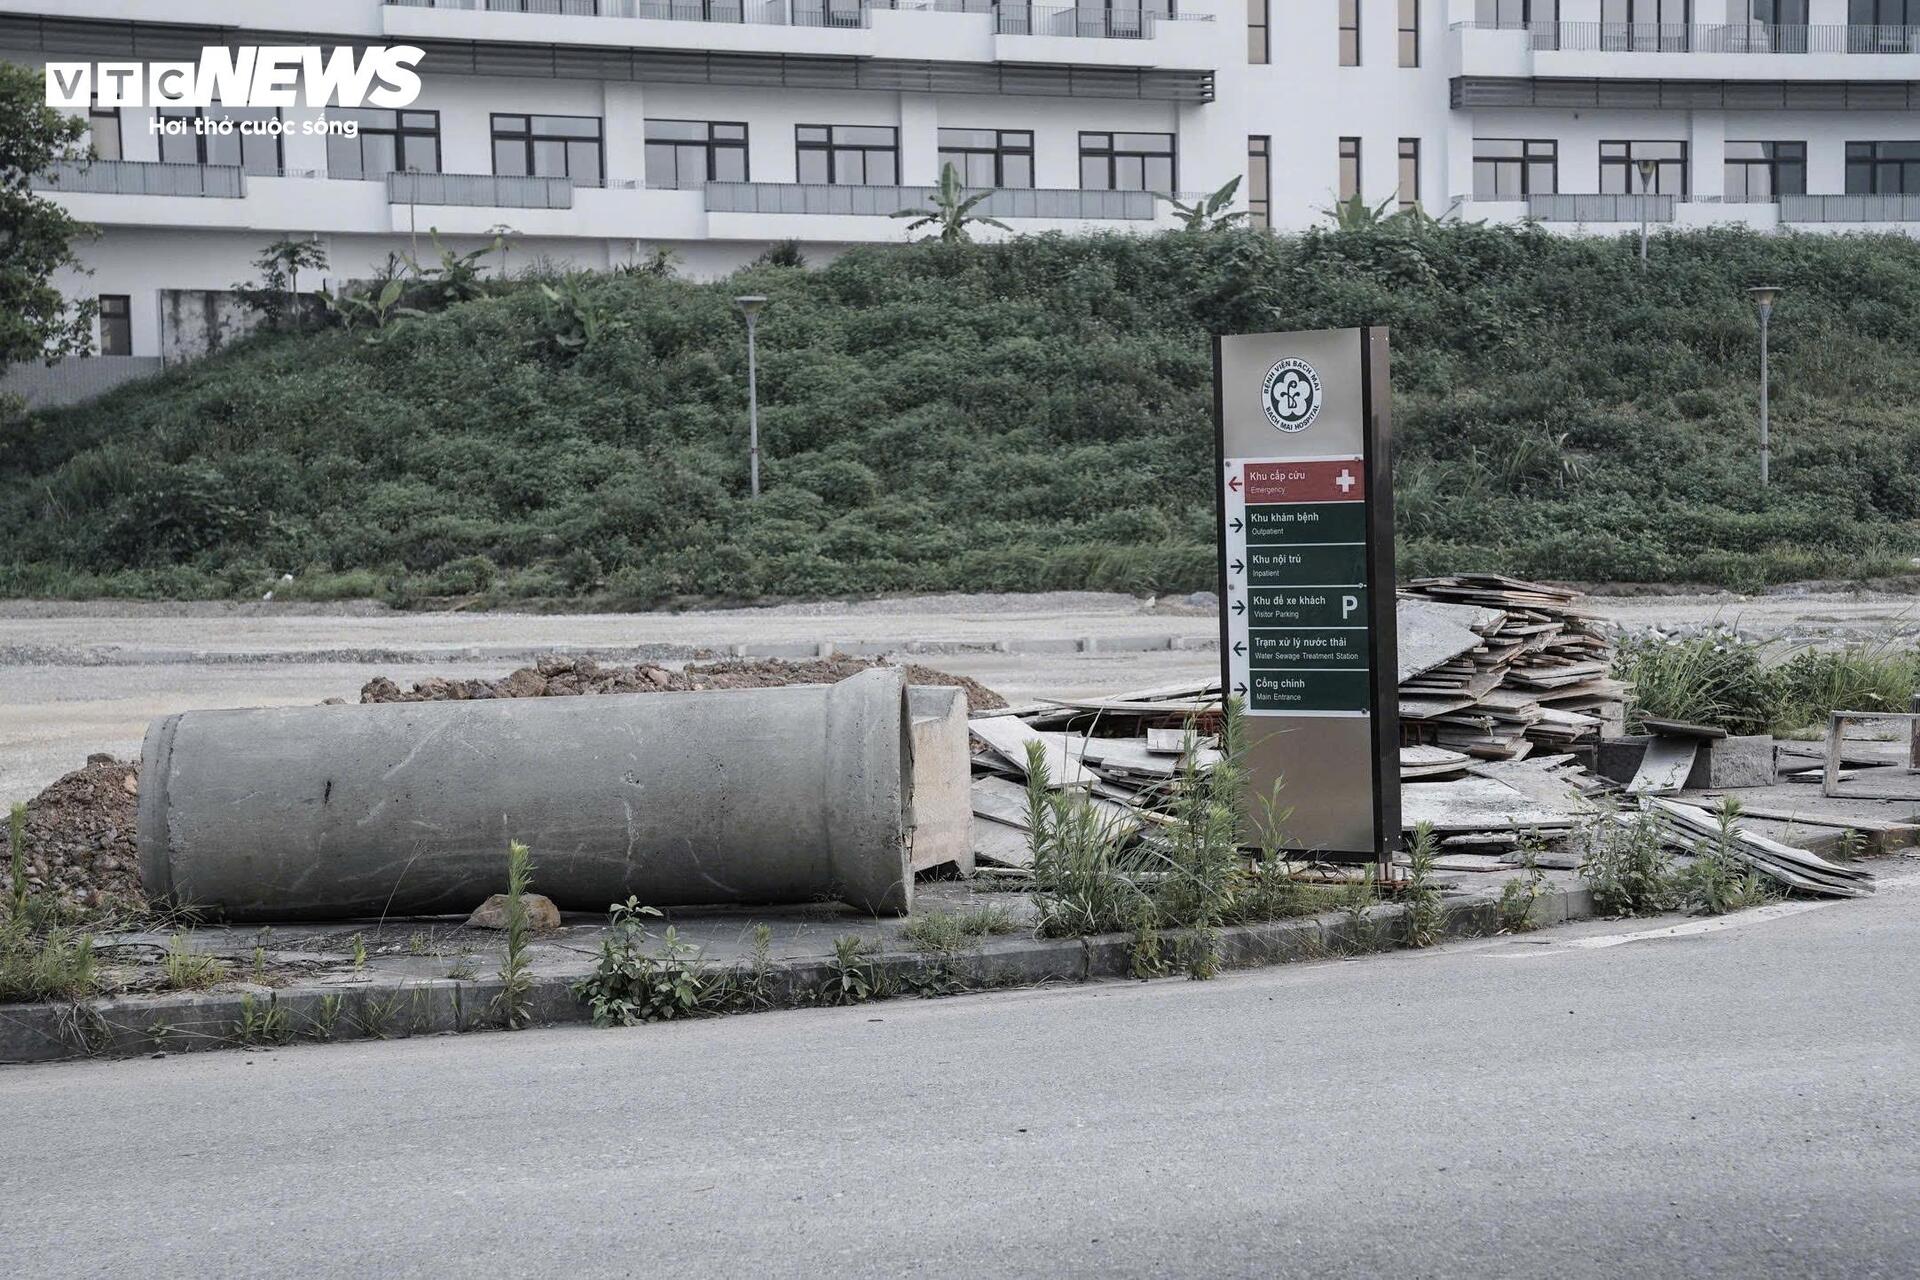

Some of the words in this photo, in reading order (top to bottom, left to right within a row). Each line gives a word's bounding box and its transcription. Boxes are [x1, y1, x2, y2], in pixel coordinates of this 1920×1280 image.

[1310, 374, 1320, 391] MAI
[1265, 406, 1280, 425] BACH
[1280, 421, 1293, 431] MAI
[1294, 404, 1320, 431] HOSPITAL
[1249, 472, 1268, 481] Khu
[1250, 486, 1286, 495] Emergency
[1250, 513, 1269, 522] Khu
[1270, 512, 1295, 522] khám
[1297, 511, 1320, 523] bệnh
[1251, 527, 1284, 536] Outpatient
[1252, 555, 1271, 564] Khu
[1272, 554, 1287, 565] nội
[1252, 569, 1280, 577] Inpatient
[1253, 595, 1271, 605] Khu
[1273, 593, 1284, 605] để
[1286, 597, 1297, 605] xe
[1299, 595, 1326, 605] khách
[1342, 595, 1358, 619] P
[1253, 610, 1274, 618] Visitor
[1275, 610, 1300, 619] Parking
[1254, 637, 1276, 648] Trạm
[1278, 636, 1291, 647] xử
[1292, 637, 1301, 649] lý
[1303, 637, 1327, 647] nước
[1329, 637, 1347, 647] thải
[1254, 652, 1273, 660] Water
[1275, 652, 1300, 660] Sewage
[1302, 652, 1334, 660] Treatment
[1336, 651, 1359, 660] Station
[1256, 693, 1272, 701] Main
[1273, 693, 1301, 701] Entrance
